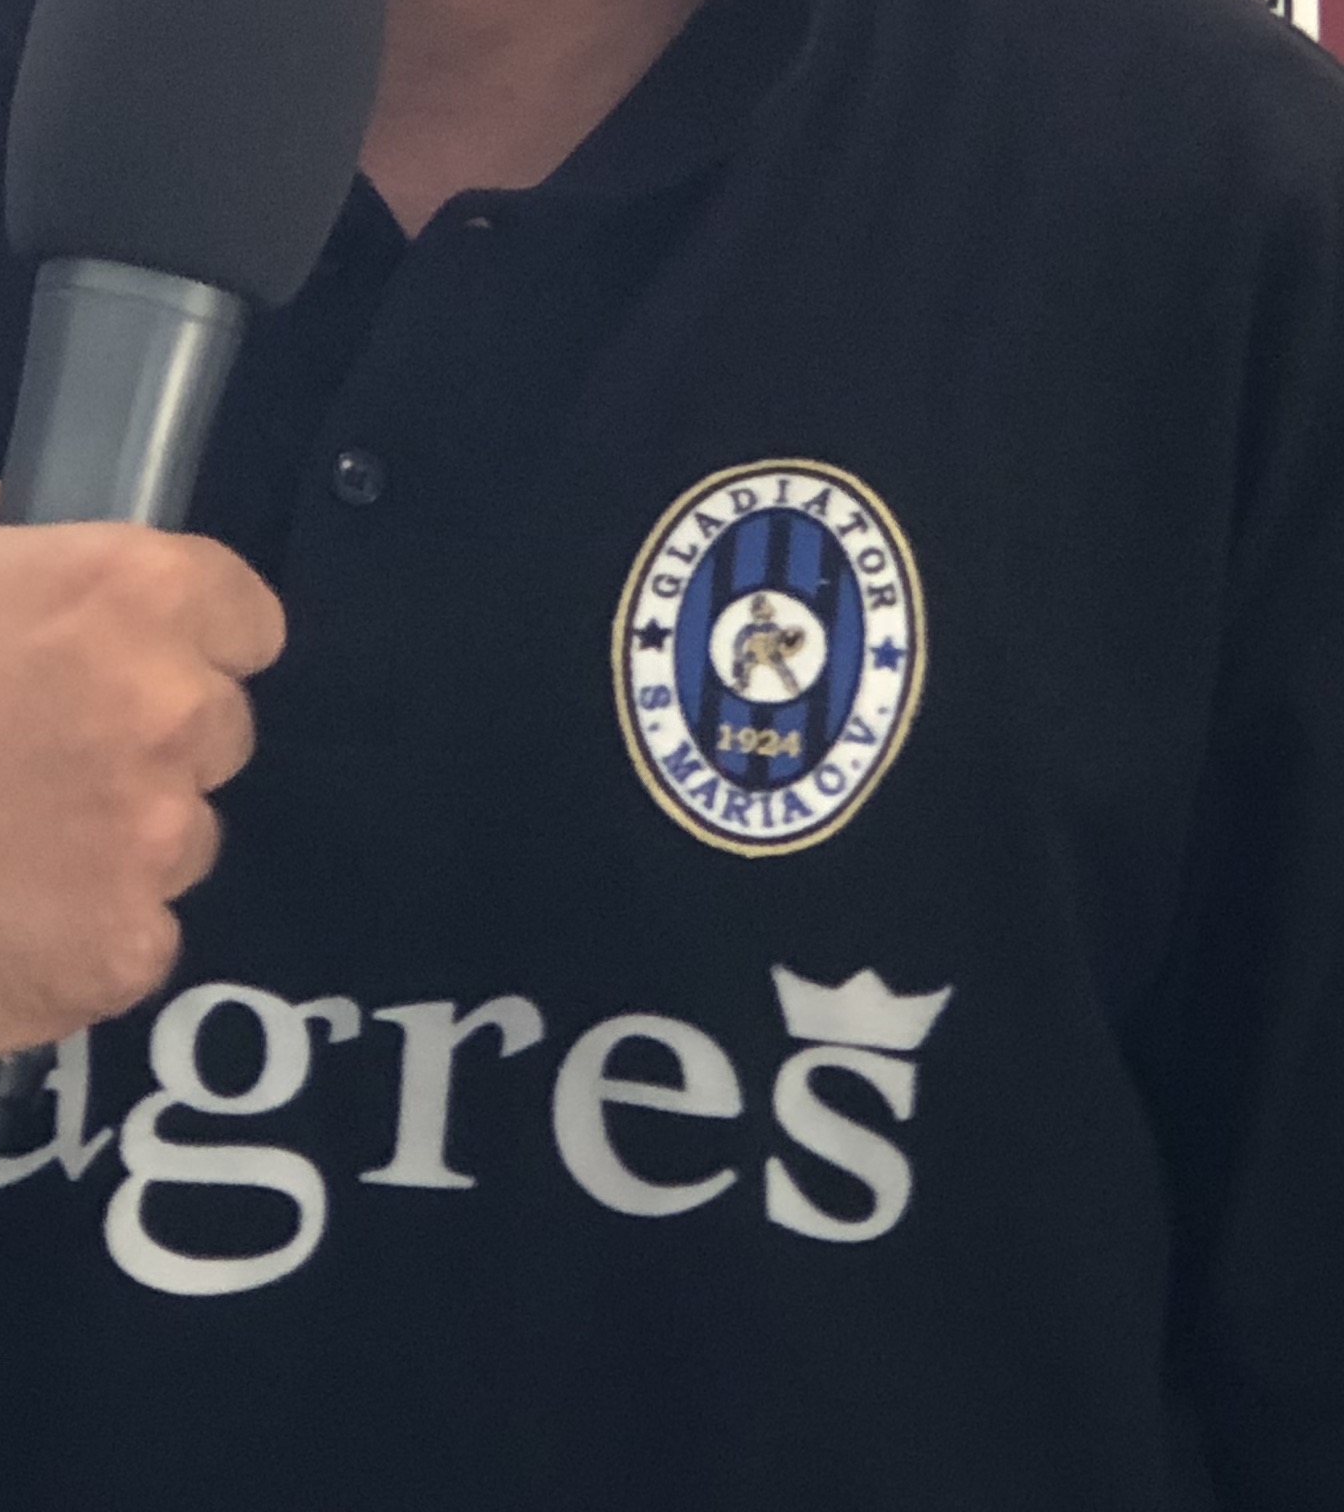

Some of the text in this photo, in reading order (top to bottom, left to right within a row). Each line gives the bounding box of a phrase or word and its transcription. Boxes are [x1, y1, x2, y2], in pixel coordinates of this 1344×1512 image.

[650, 479, 898, 612] GLADIATOR
[662, 741, 813, 829] MARIA
[716, 723, 802, 759] 1924
